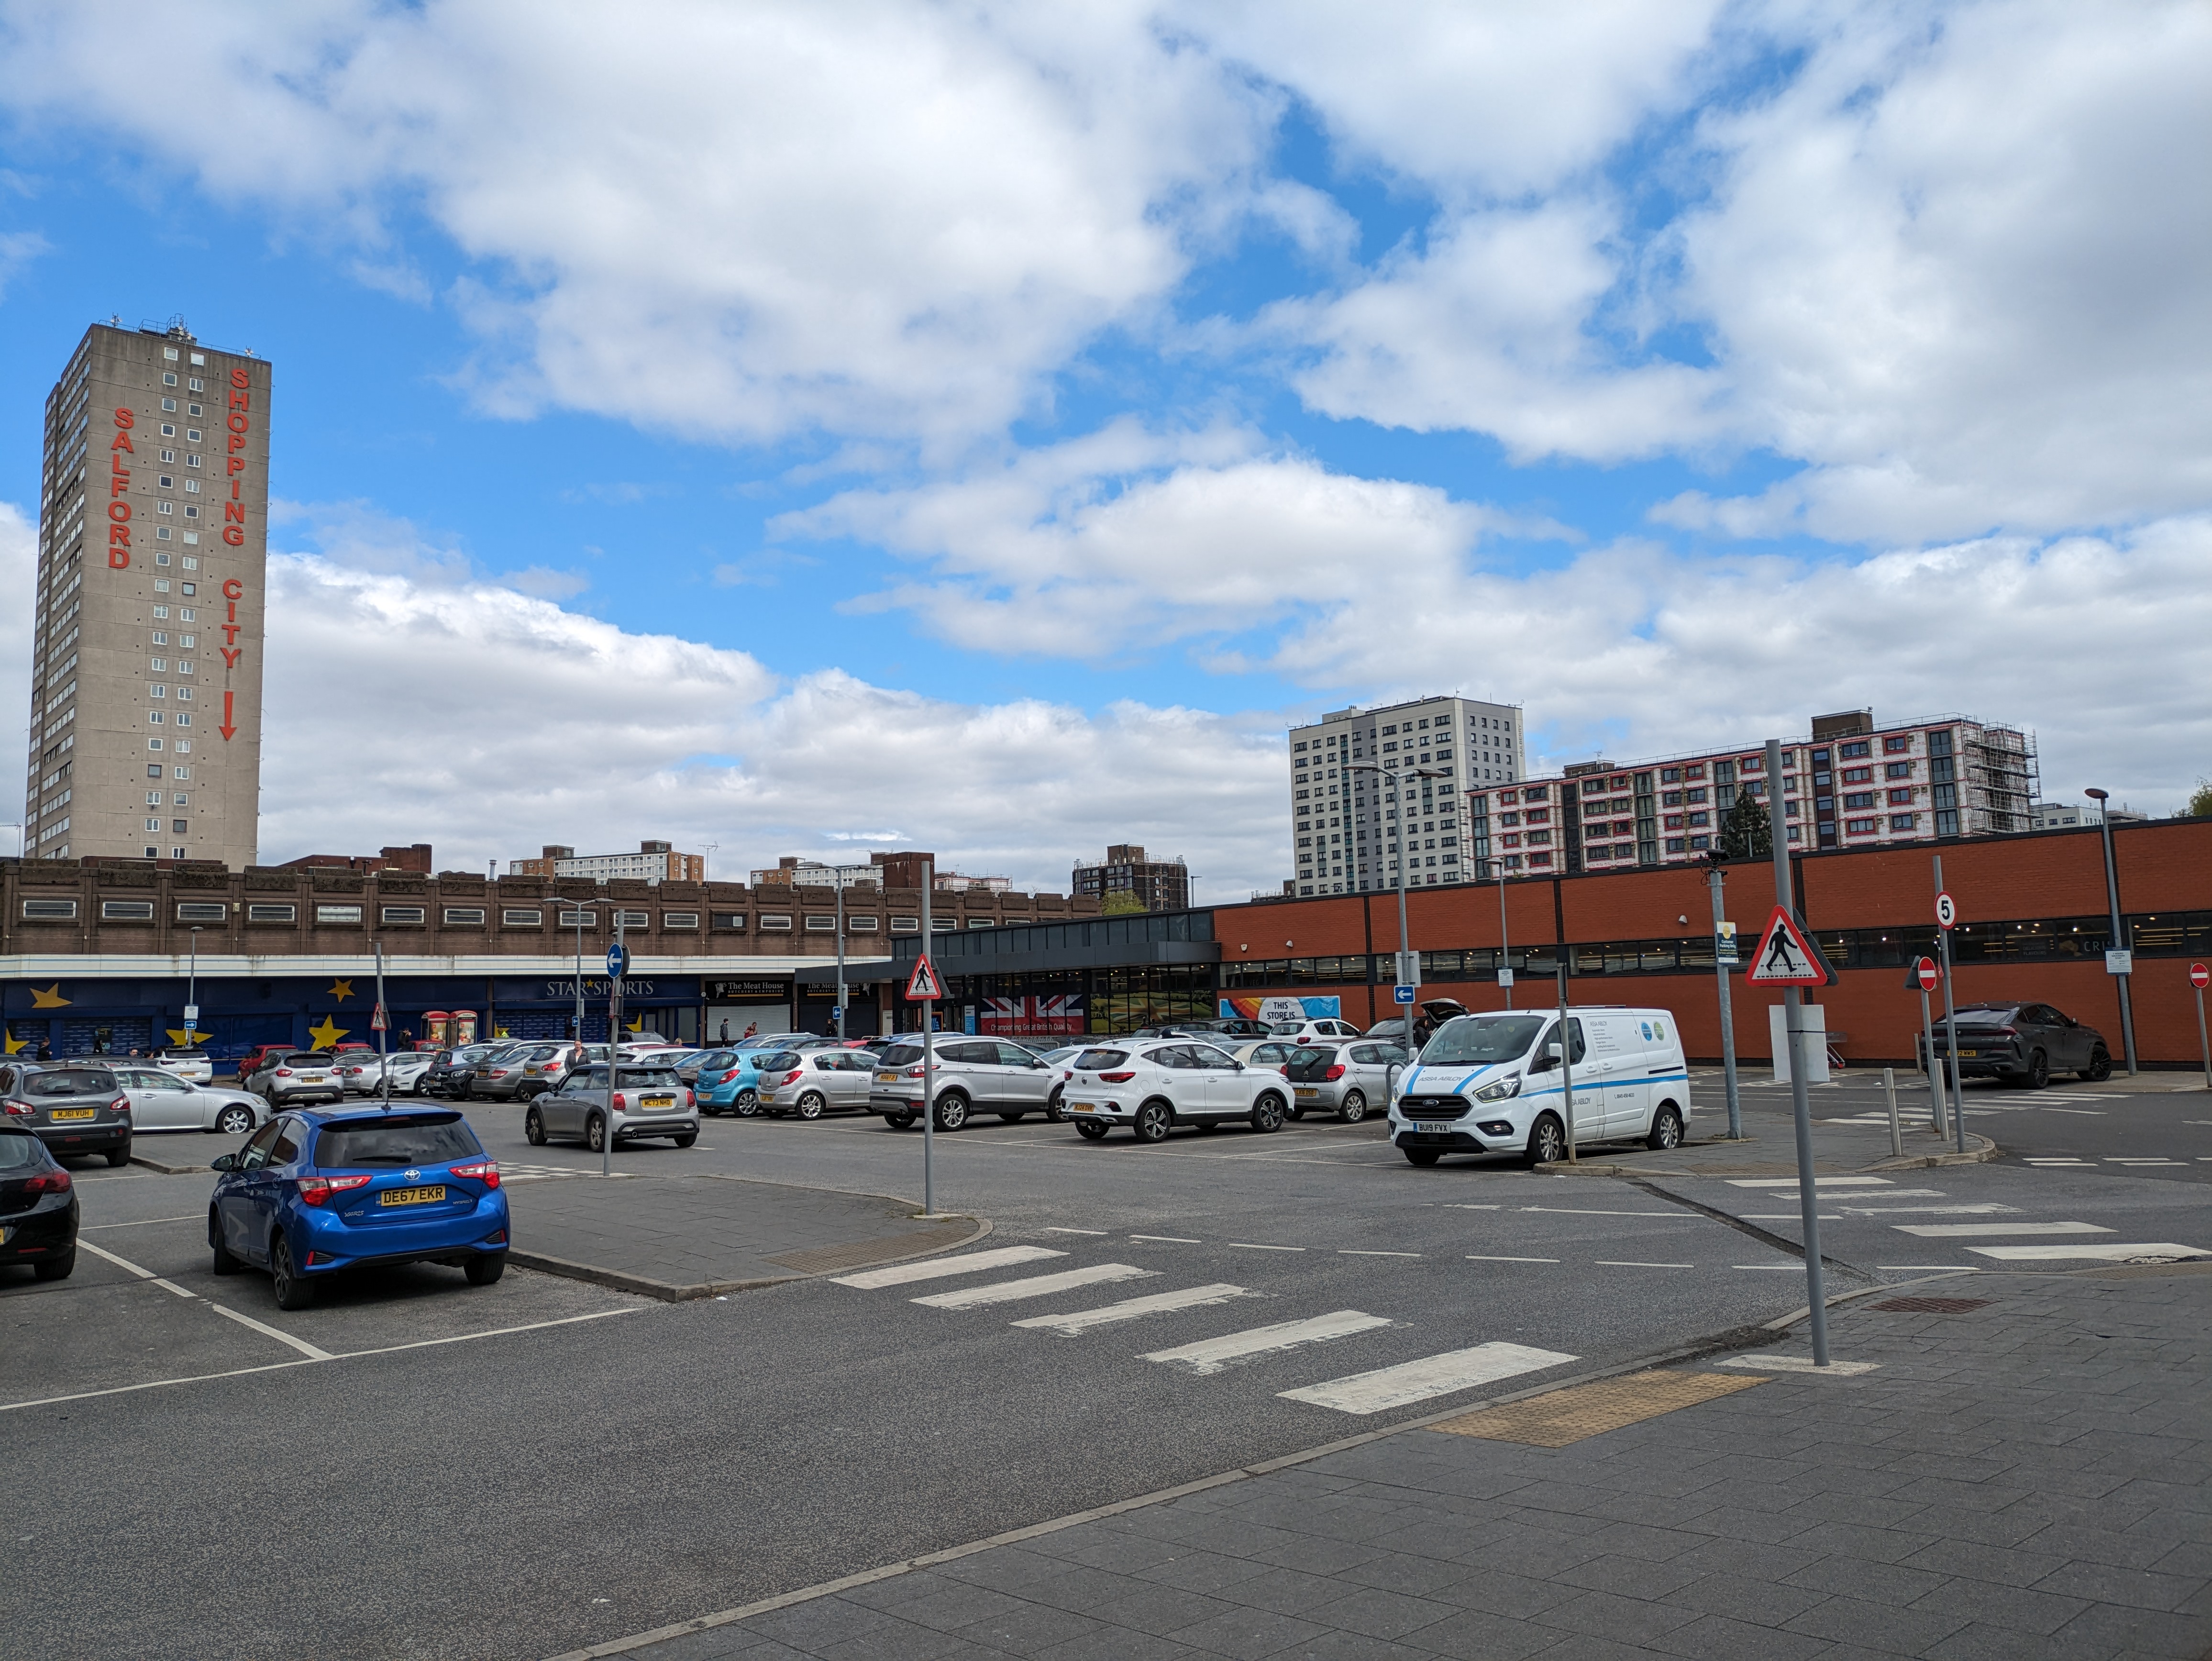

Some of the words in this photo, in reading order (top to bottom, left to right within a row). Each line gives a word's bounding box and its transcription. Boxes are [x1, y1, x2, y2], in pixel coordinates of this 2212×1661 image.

[223, 367, 249, 547] SHOPPING
[108, 407, 134, 569] SALFORD
[220, 578, 243, 669] CITY
[1941, 900, 1950, 920] 5
[2084, 941, 2110, 952] CRI
[547, 981, 589, 996] STAR
[384, 1190, 416, 1204] DE67
[420, 1187, 443, 1200] EKR
